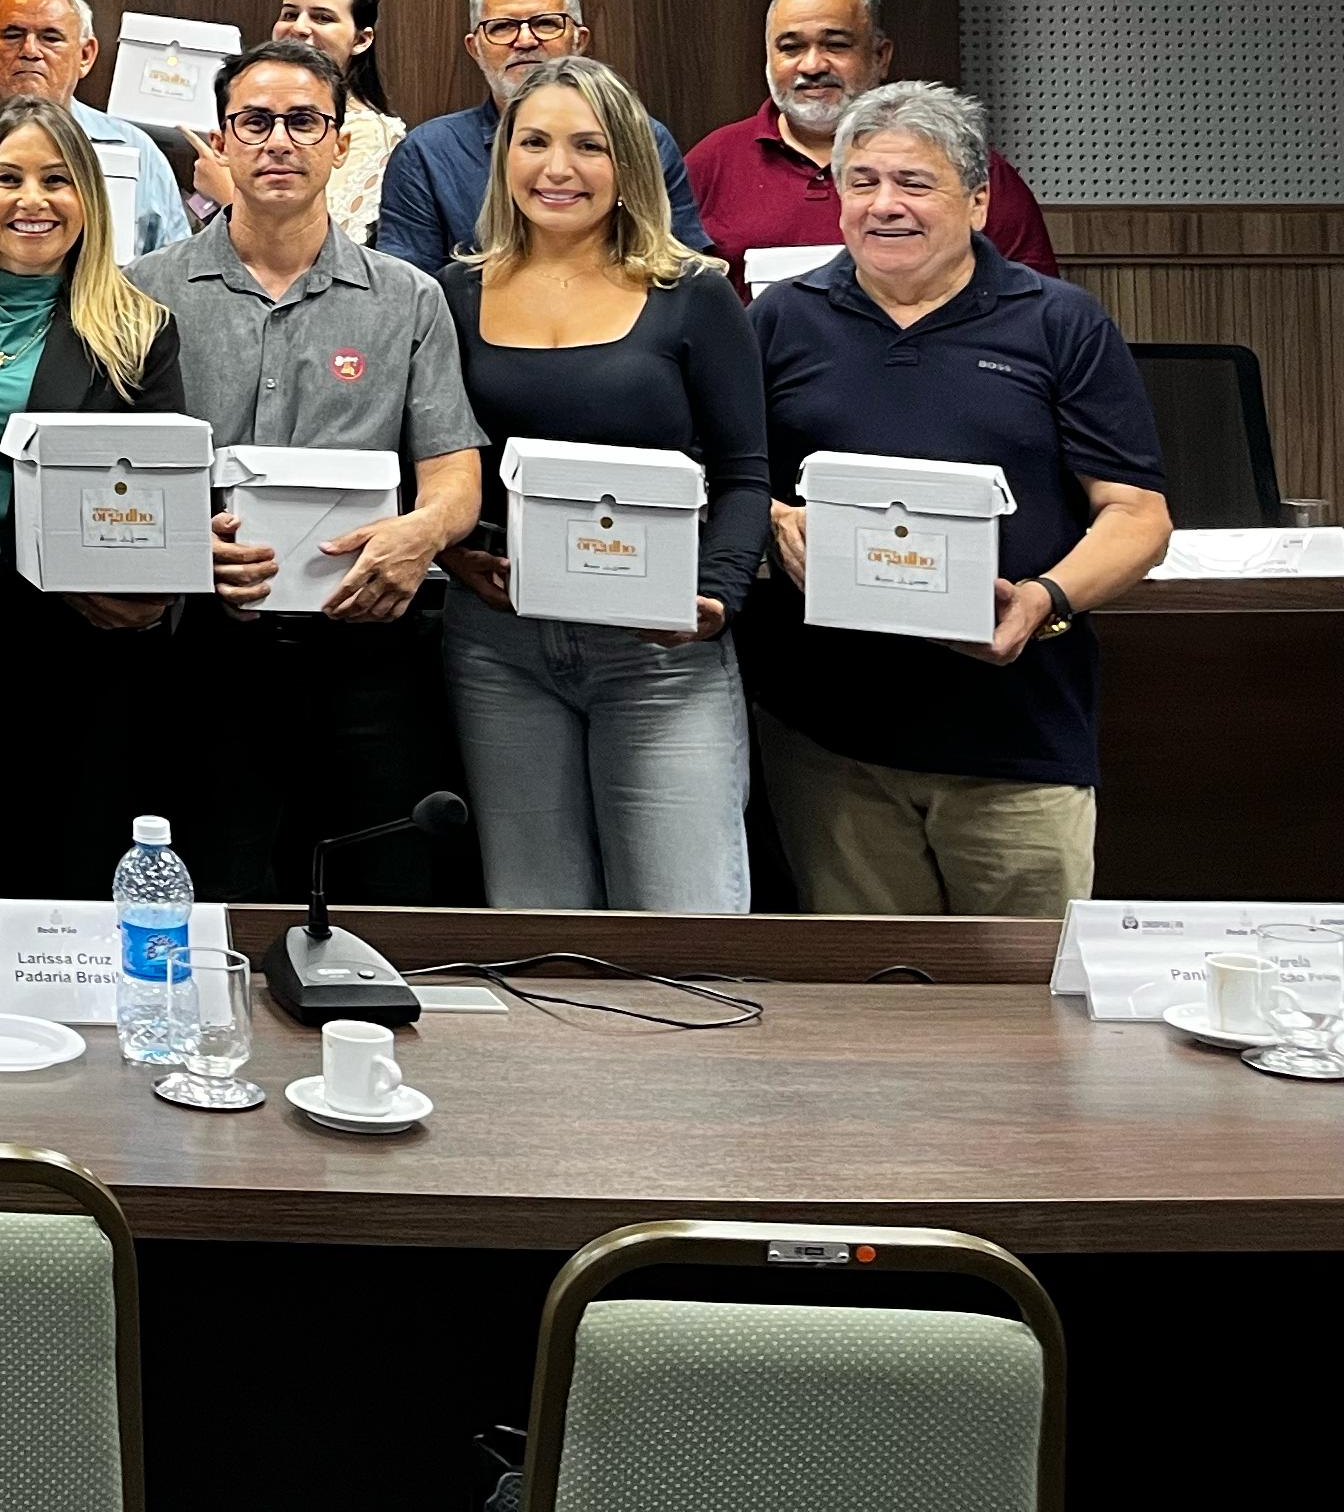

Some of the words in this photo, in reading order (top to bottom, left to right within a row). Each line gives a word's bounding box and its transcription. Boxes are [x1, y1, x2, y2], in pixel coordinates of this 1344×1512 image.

[17, 951, 73, 966] Larissa
[77, 952, 113, 966] Cruz
[15, 969, 72, 984] Padaria
